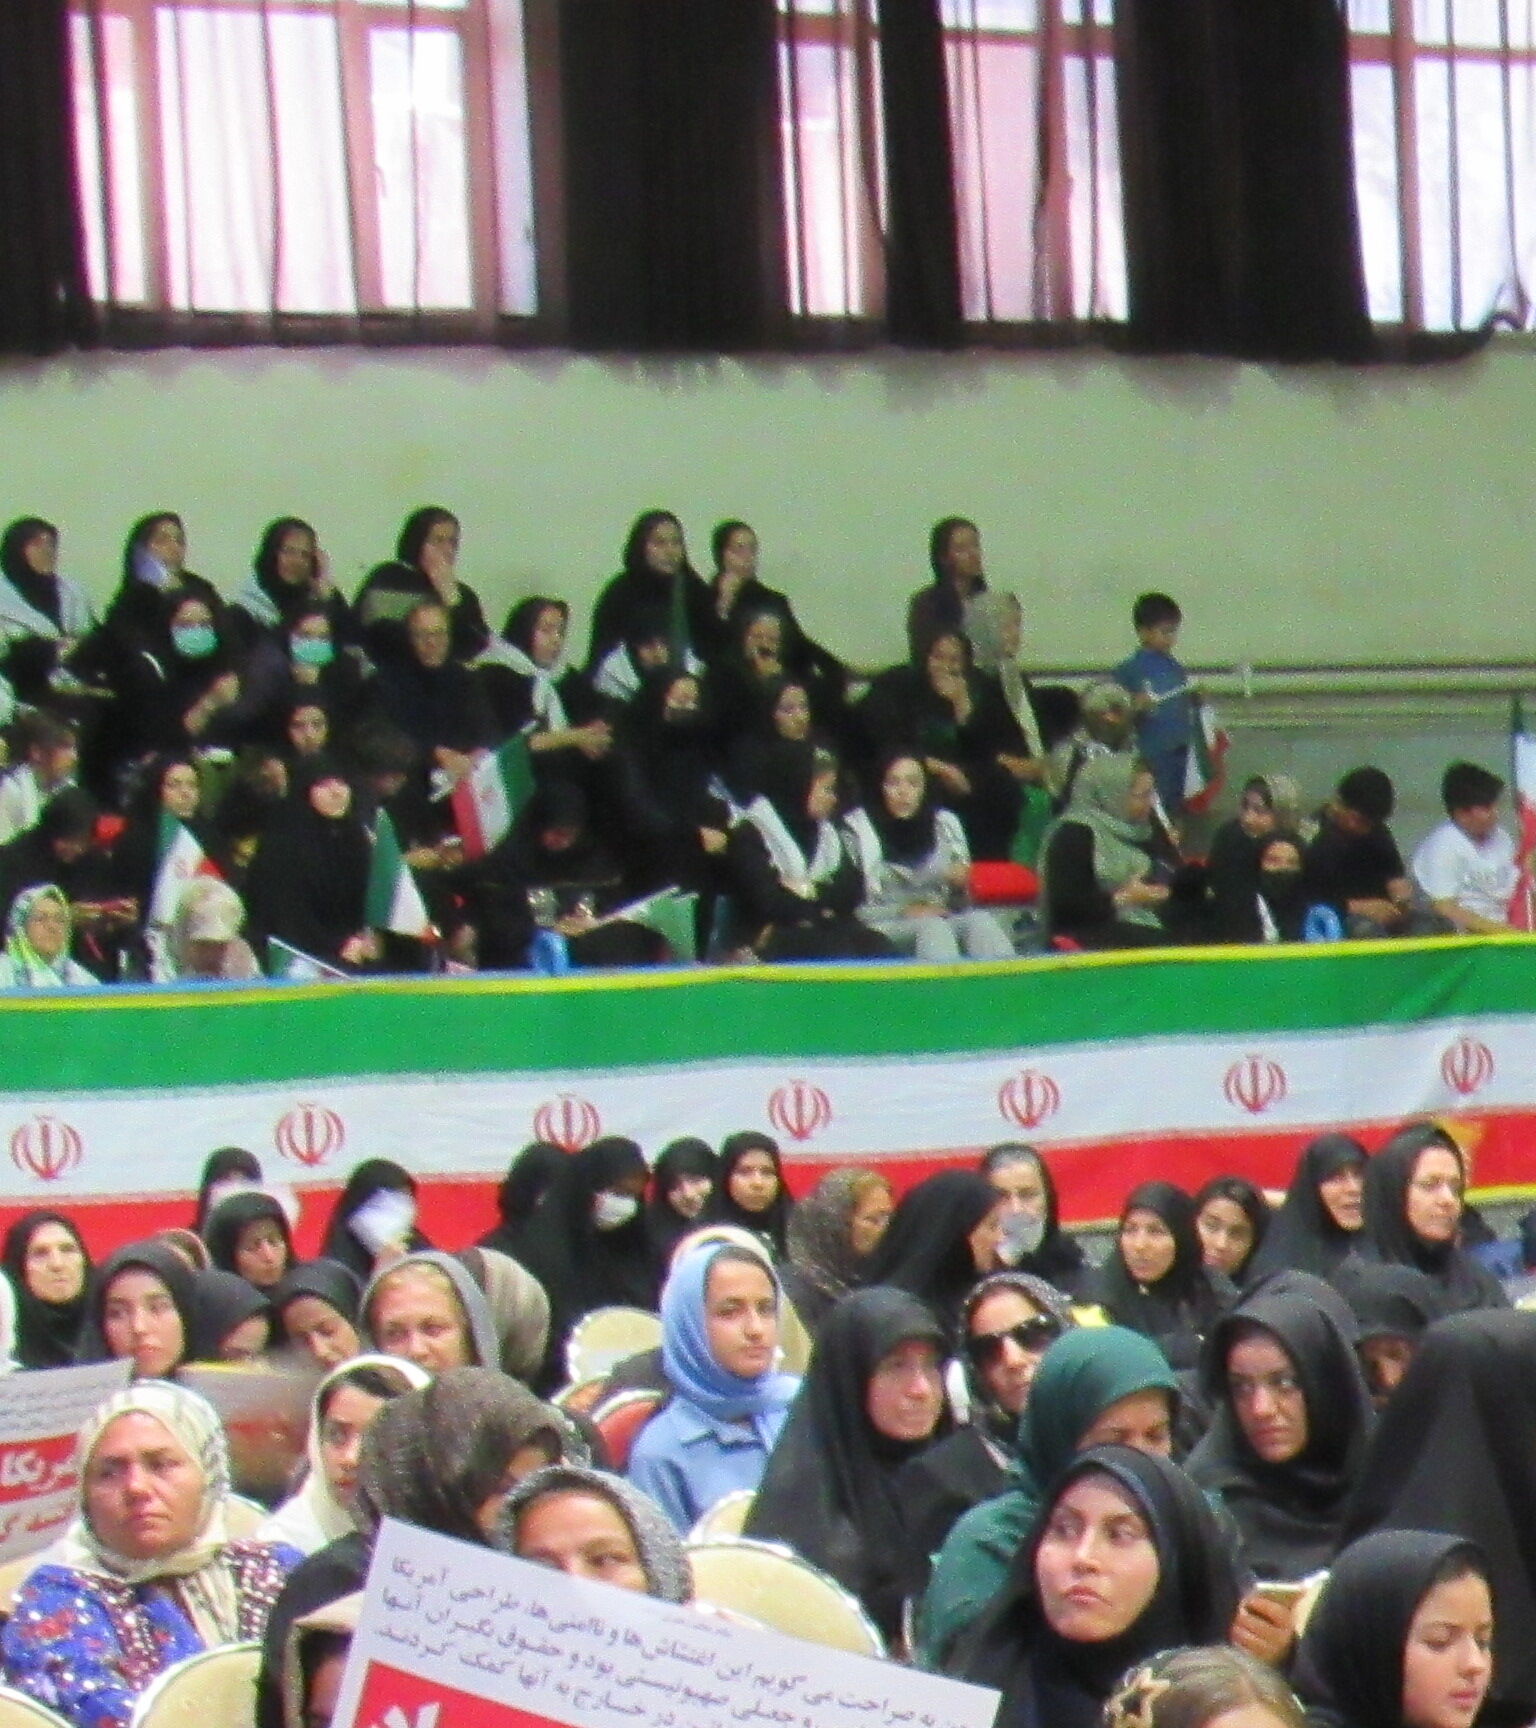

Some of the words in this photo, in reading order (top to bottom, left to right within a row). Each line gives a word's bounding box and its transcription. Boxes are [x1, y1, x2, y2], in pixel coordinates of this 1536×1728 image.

[392, 1556, 447, 1590] آمریکا
[383, 1585, 422, 1611] آنها
[450, 1587, 520, 1614] طراحی
[606, 1629, 618, 1646] و
[459, 1651, 516, 1676] کمک
[568, 1652, 580, 1671] و
[585, 1655, 615, 1680] بود
[716, 1662, 752, 1682] این
[517, 1663, 553, 1690] آنها
[555, 1680, 571, 1695] به
[616, 1669, 730, 1707] صهیونیستی
[573, 1689, 646, 1716] خارج
[731, 1699, 795, 1727] جعلی
[838, 1692, 916, 1726] صراحت
[651, 1711, 676, 1728] در
